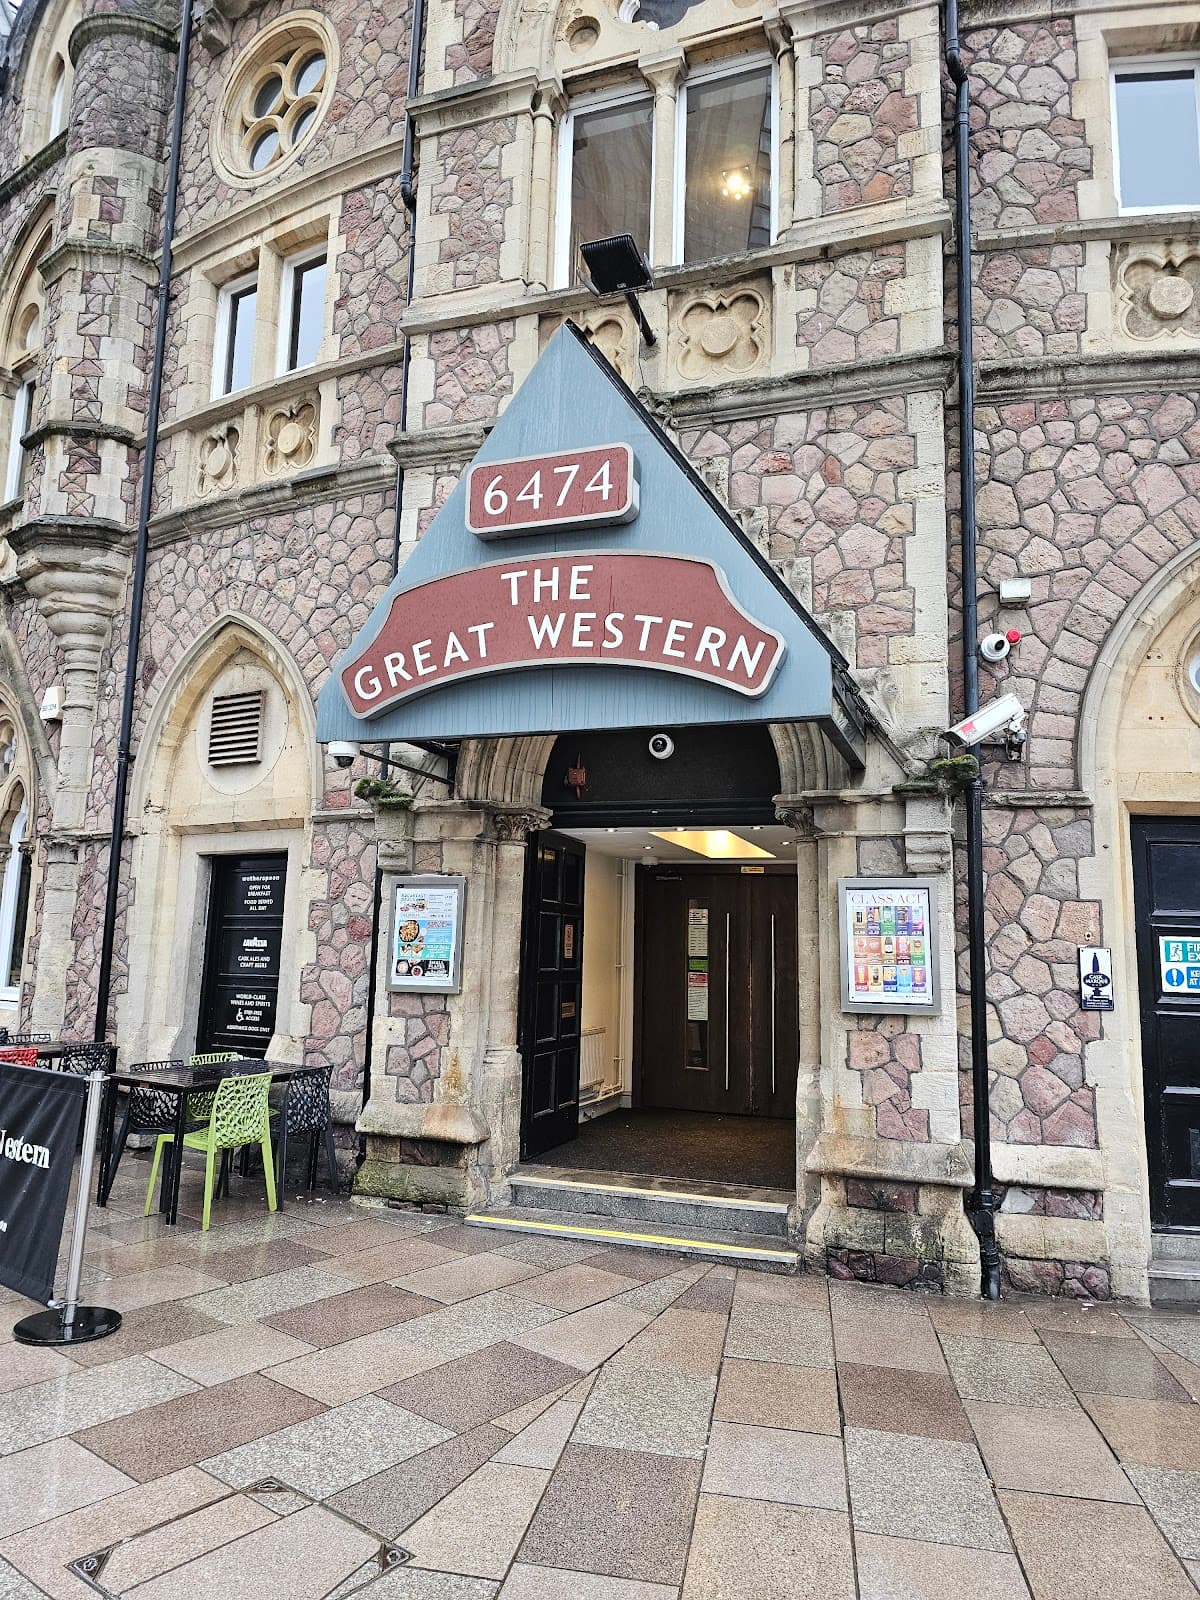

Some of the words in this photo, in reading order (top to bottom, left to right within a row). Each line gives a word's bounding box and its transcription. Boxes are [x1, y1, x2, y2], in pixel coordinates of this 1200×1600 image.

[483, 460, 613, 515] 6474
[500, 564, 594, 606] THE
[354, 622, 494, 700] GREAT
[527, 612, 766, 678] WESTERN
[851, 894, 894, 905] CLASS
[897, 893, 922, 905] ACT
